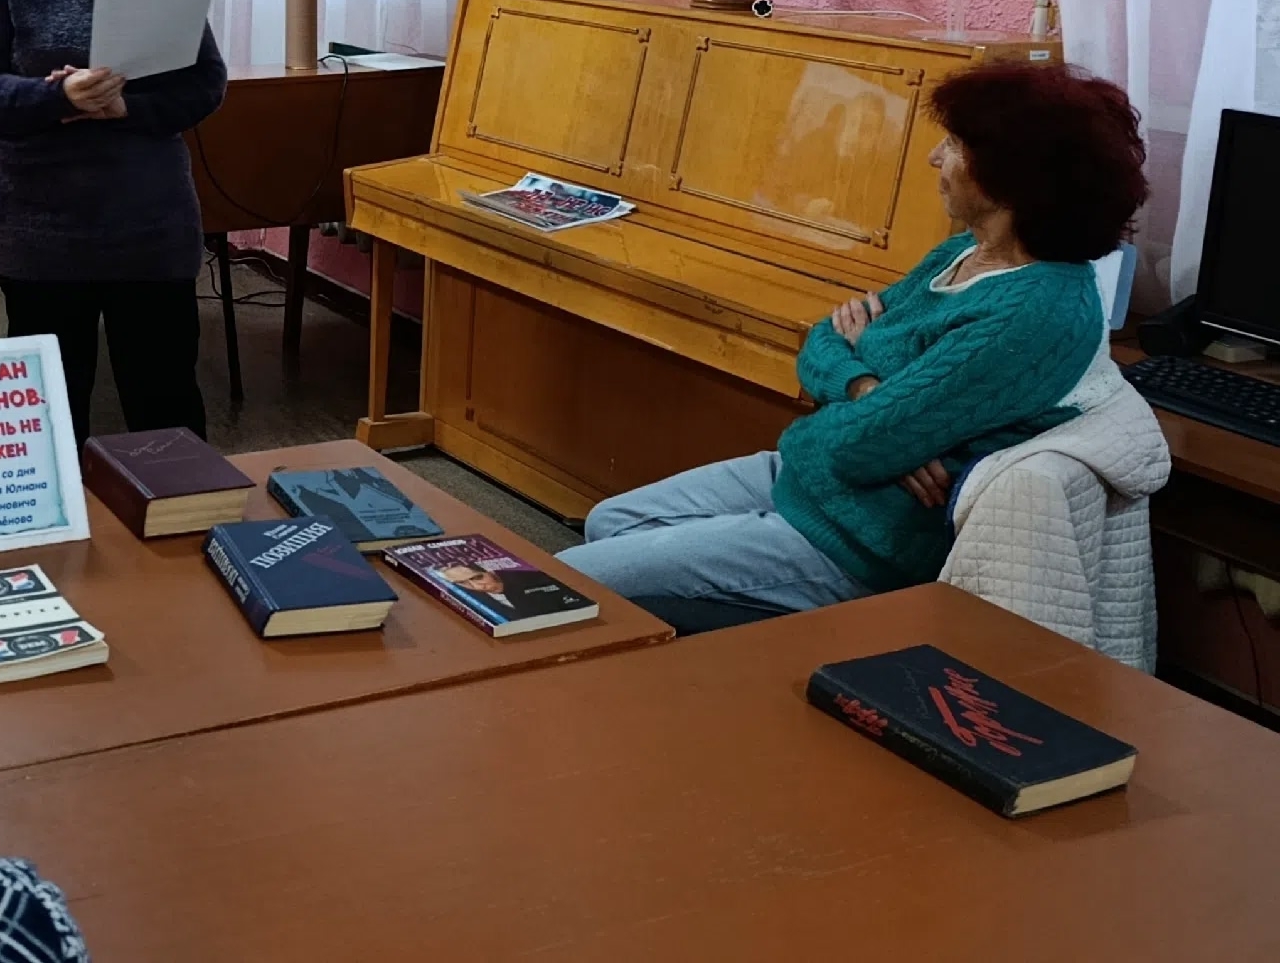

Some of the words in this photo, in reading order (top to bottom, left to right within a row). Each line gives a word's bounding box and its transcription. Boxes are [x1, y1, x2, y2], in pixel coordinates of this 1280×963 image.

[19, 418, 42, 433] НЕ
[2, 470, 14, 478] со
[16, 467, 36, 477] дня
[6, 482, 48, 494] Юлиана
[249, 521, 334, 569] ПОЗИЦИЯ
